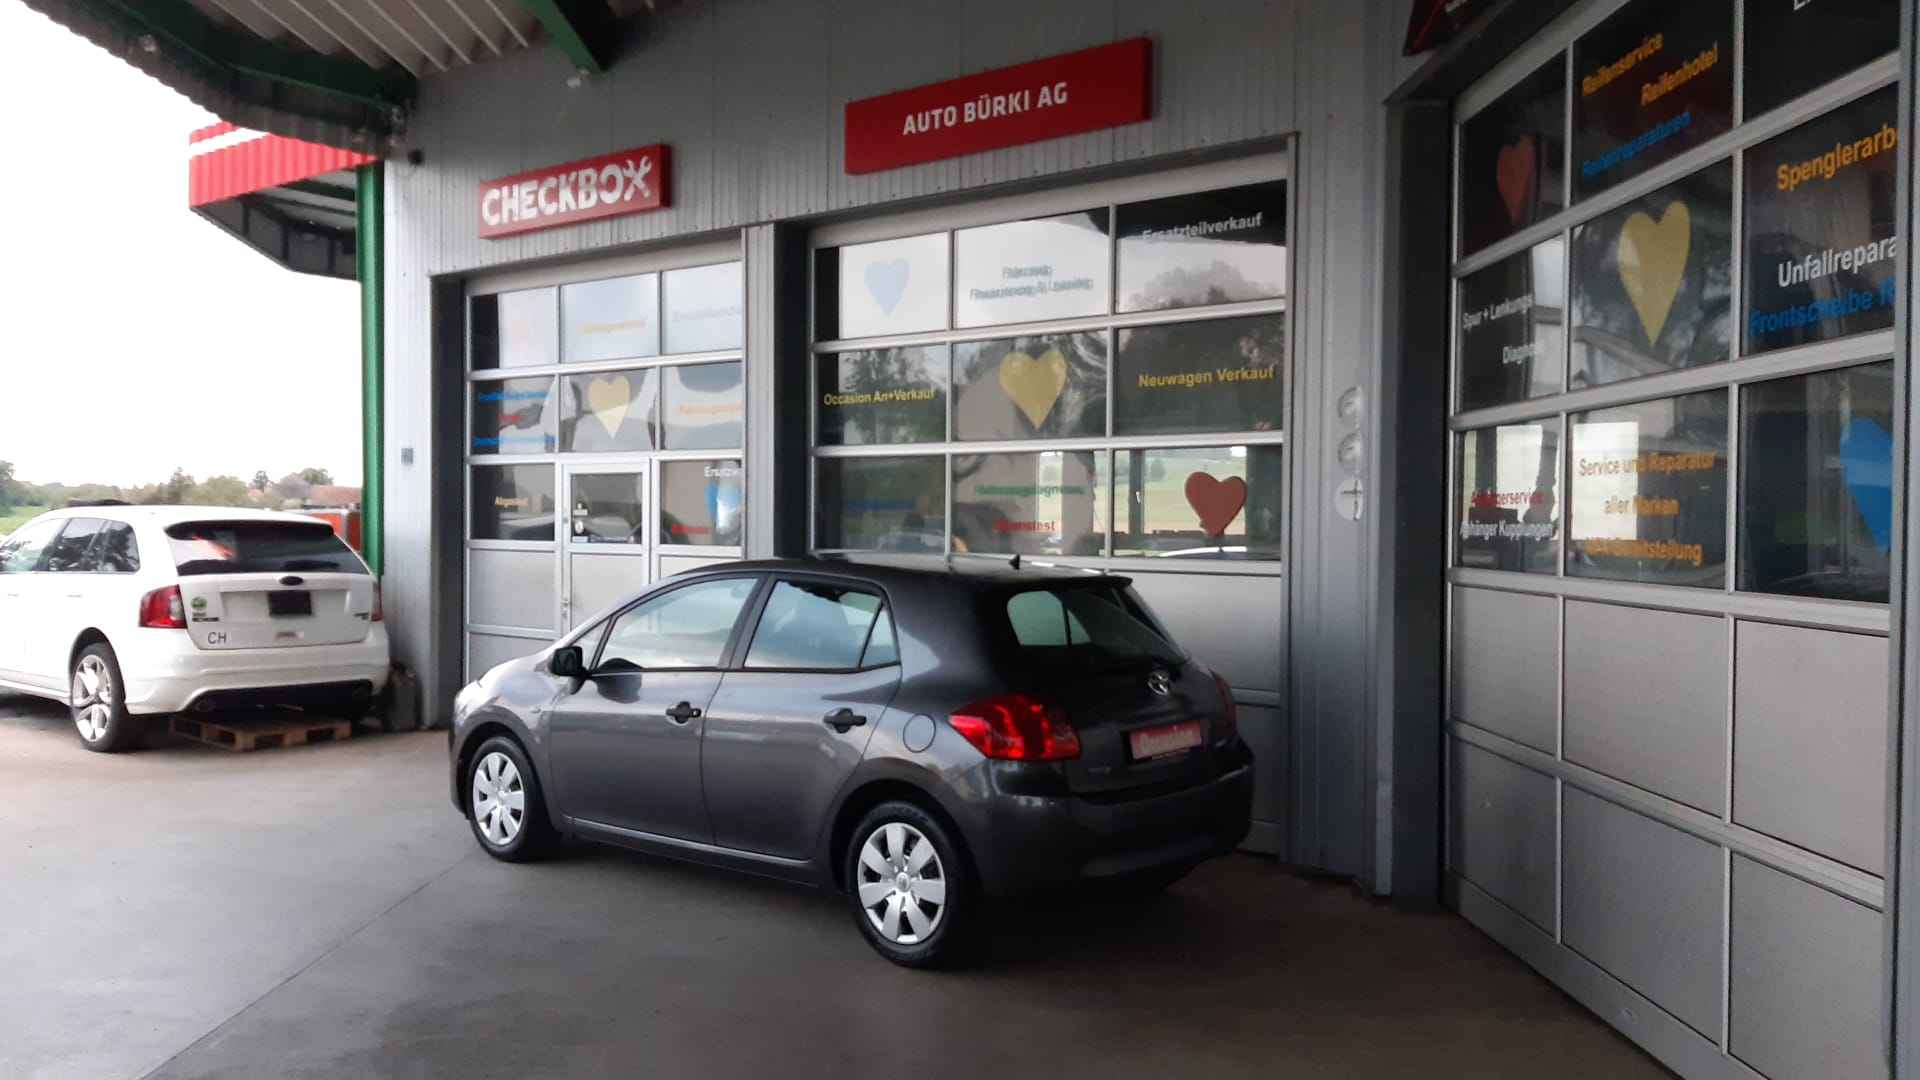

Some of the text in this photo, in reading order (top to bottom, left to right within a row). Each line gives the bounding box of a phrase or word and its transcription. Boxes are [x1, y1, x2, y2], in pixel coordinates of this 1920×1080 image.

[903, 81, 1068, 136] AUTO BÜRKI AG
[481, 156, 652, 226] CHECKBOX
[1142, 211, 1263, 242] Ersatzteilverkauf
[1138, 364, 1275, 388] Neuwagen Verkauf
[823, 393, 871, 406] Occasion
[1579, 458, 1619, 476] Service
[207, 631, 227, 644] CH
